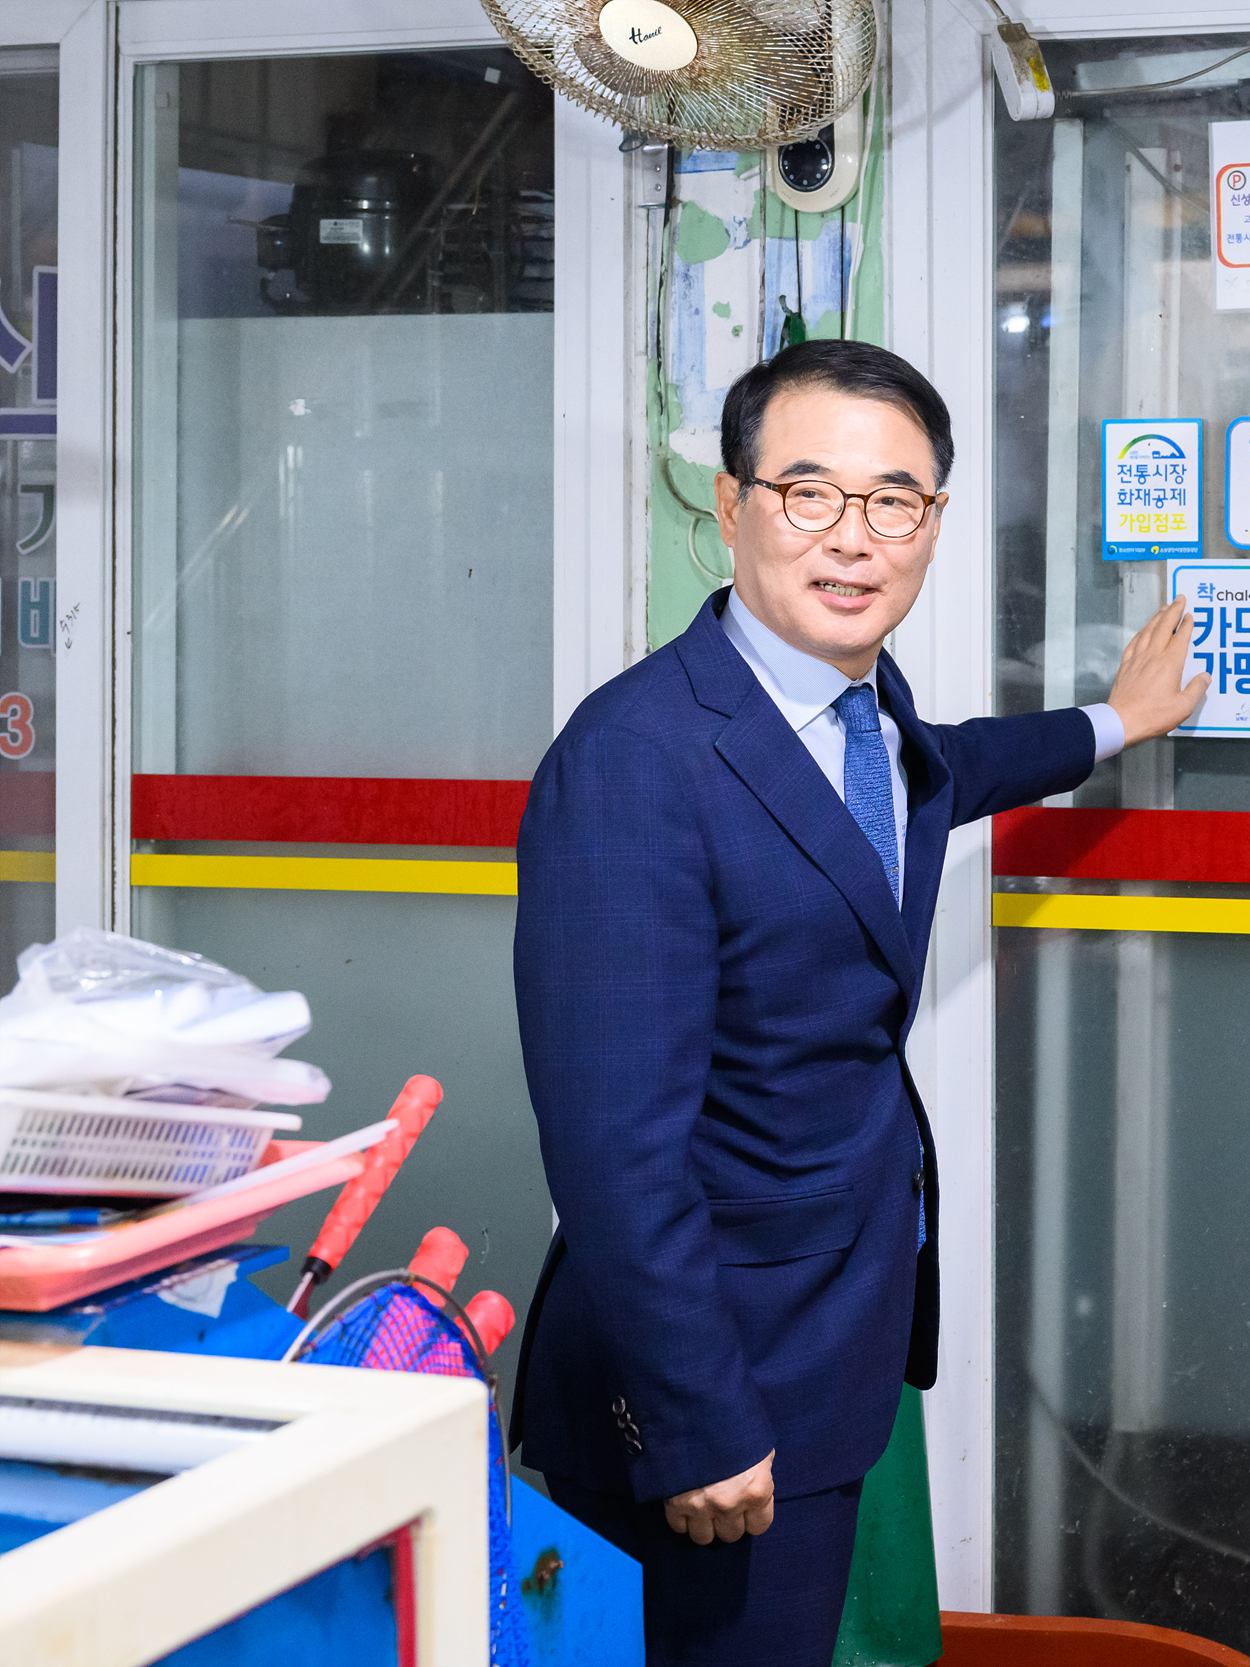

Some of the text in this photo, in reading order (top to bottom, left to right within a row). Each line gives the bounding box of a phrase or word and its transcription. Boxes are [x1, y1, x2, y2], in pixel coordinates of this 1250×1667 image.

[1117, 464, 1187, 485] 전통시장
[1117, 488, 1187, 509] 화재공제
[1119, 513, 1187, 534] 가입점포
[1197, 583, 1216, 602] 착
